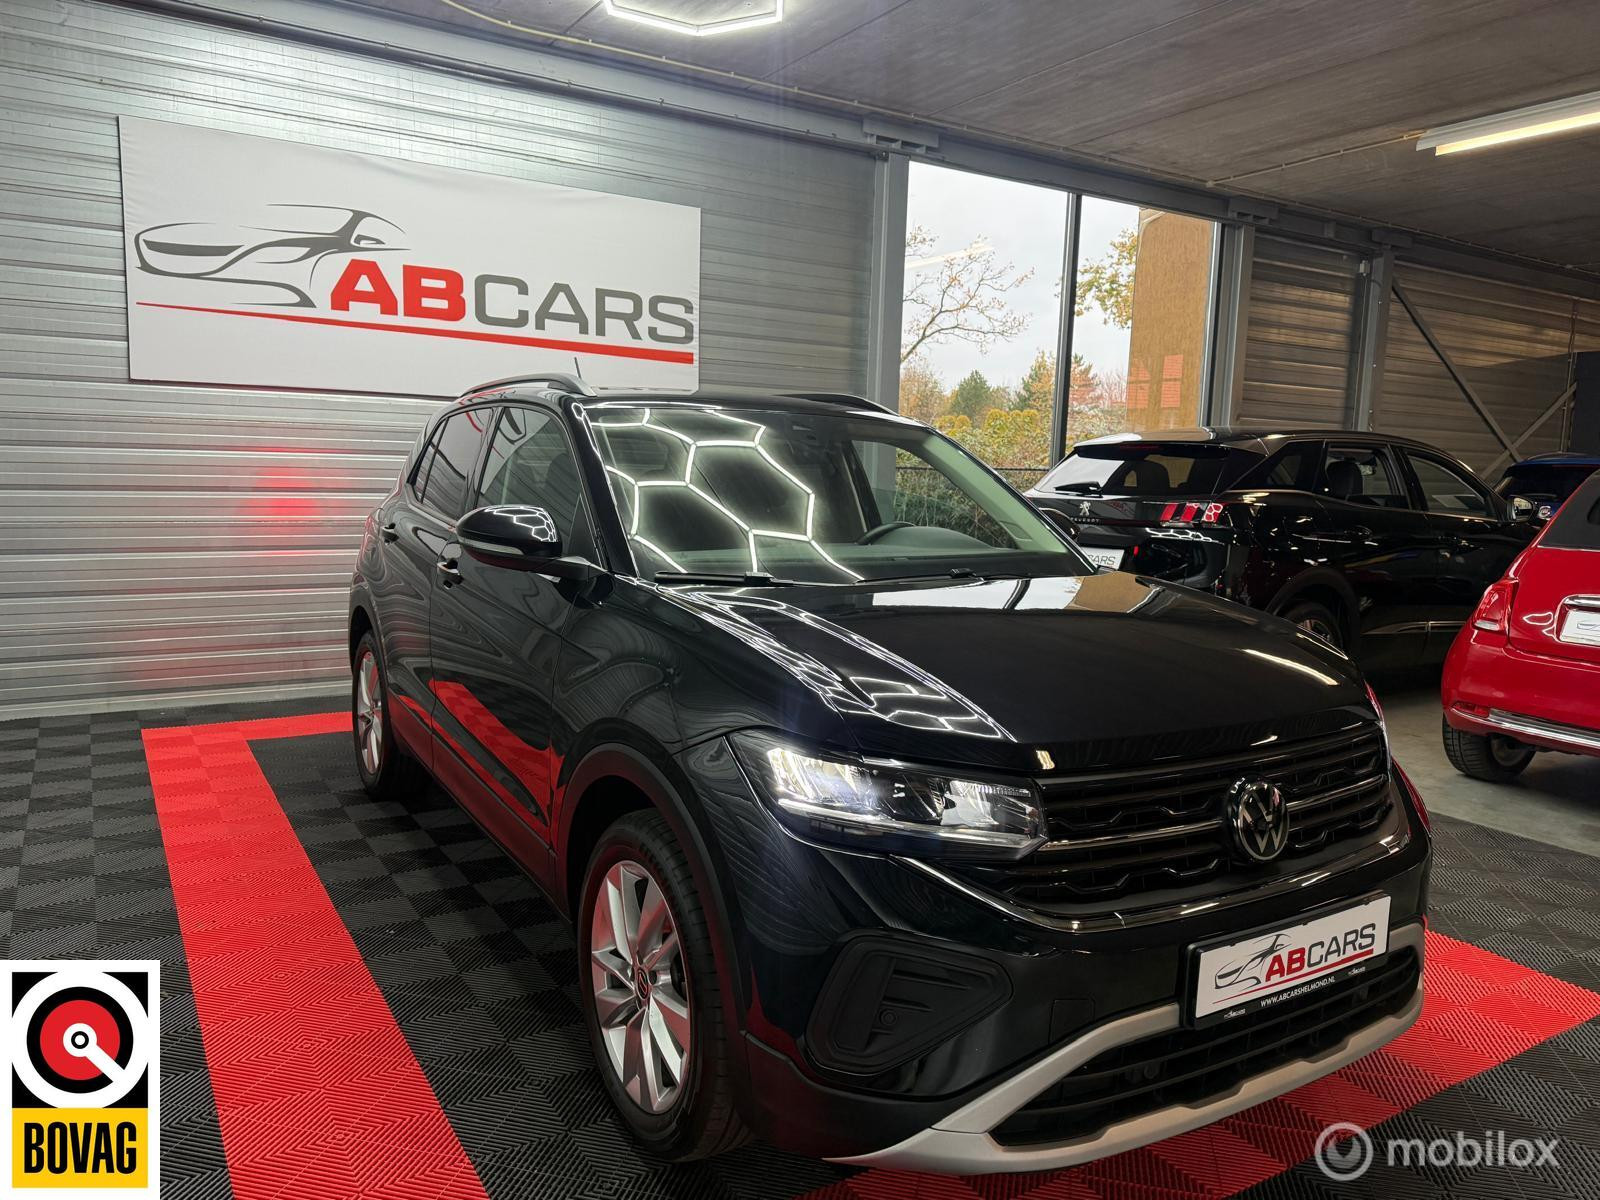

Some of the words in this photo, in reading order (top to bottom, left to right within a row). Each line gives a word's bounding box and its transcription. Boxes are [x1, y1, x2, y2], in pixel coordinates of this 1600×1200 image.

[329, 257, 695, 345] ABCARS
[1264, 922, 1377, 983] ABCARS
[1260, 976, 1336, 1008] WWW.ABCARSHELMOND.NL
